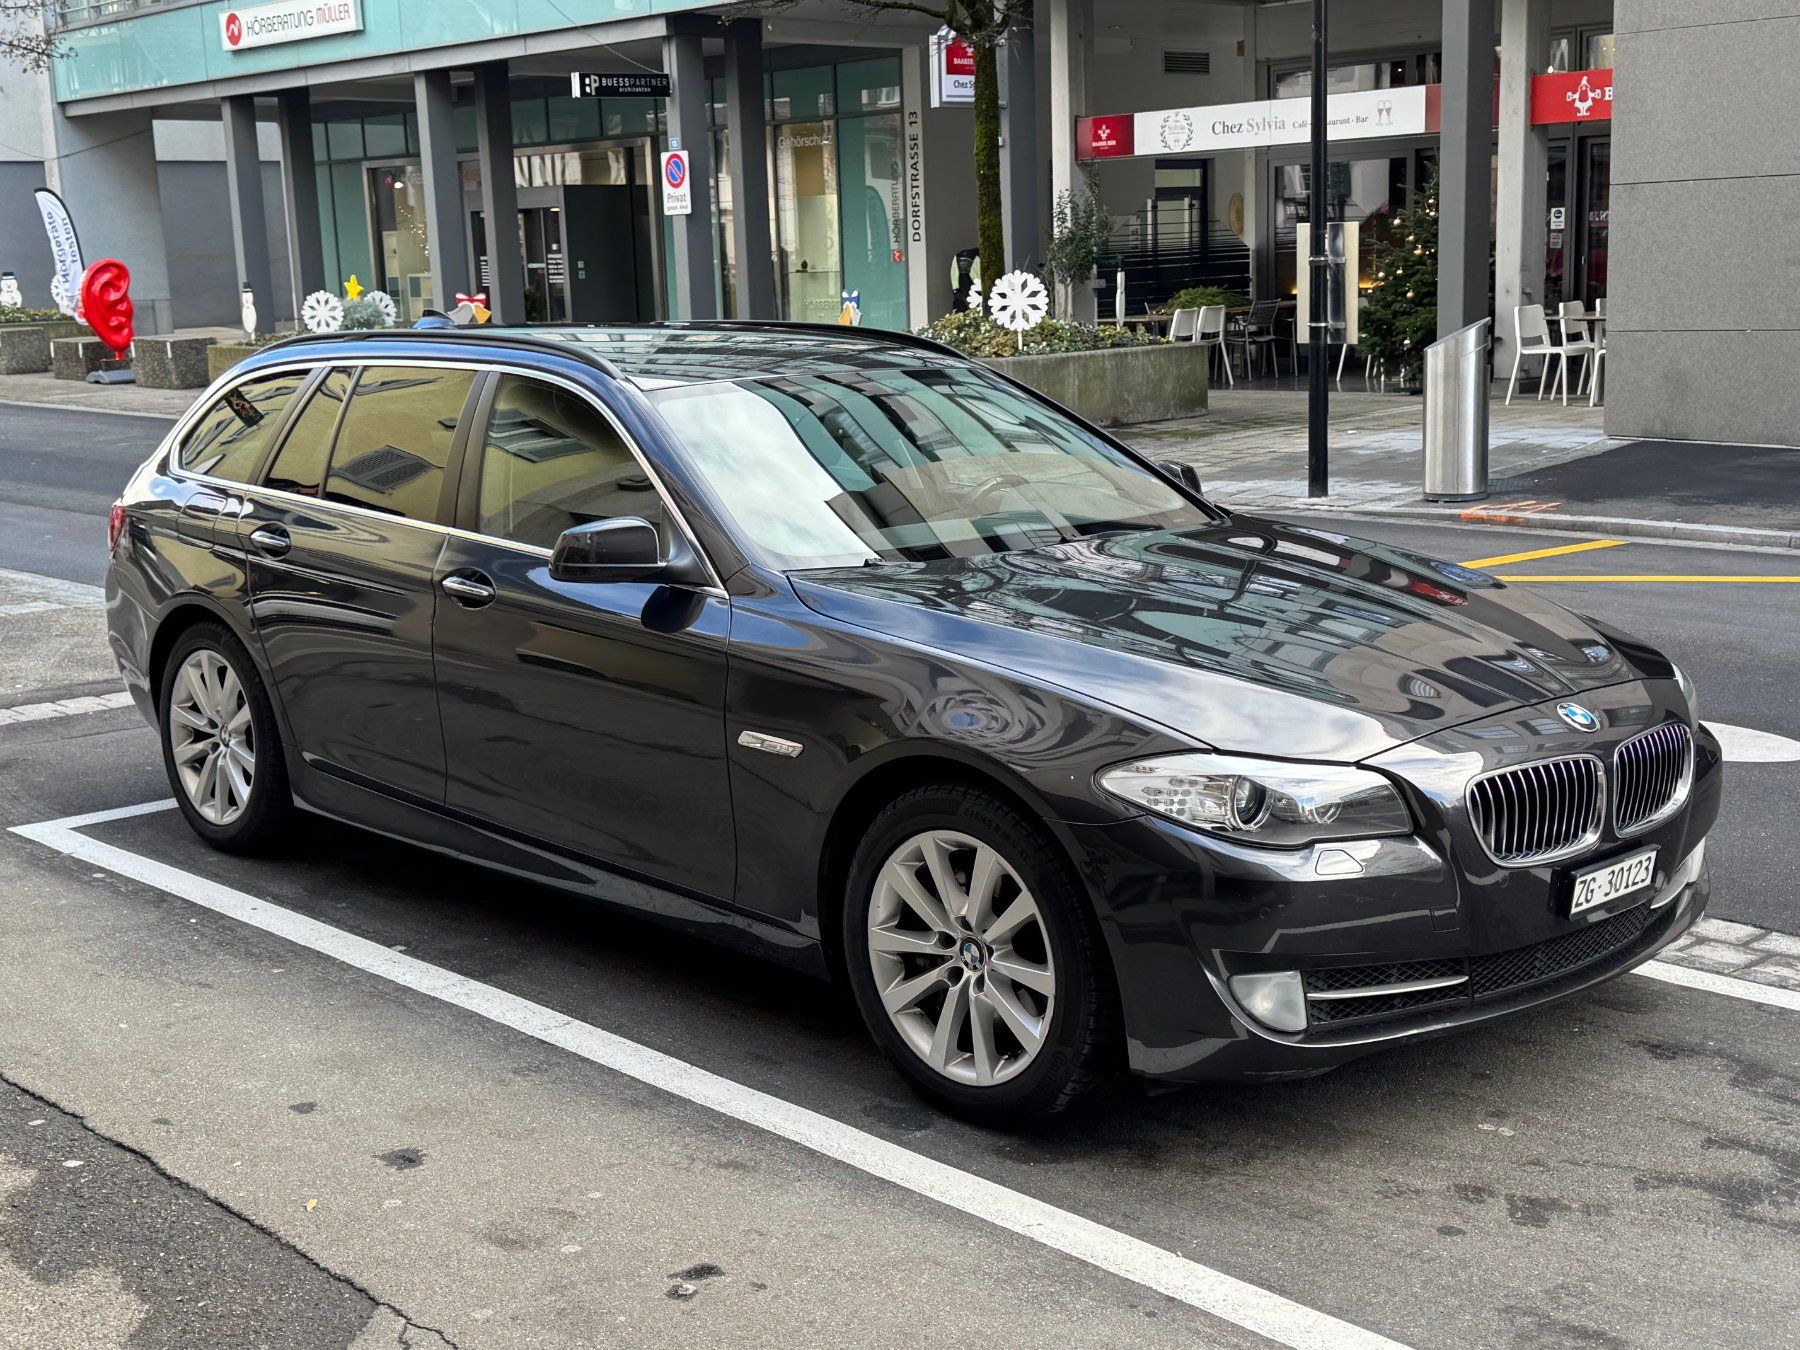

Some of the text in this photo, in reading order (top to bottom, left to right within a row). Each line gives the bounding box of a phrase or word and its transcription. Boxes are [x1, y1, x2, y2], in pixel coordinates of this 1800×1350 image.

[246, 3, 351, 37] HÖRBERATUNG MÜLLER
[602, 77, 668, 87] BUESSPARTNER
[953, 79, 968, 89] Chez
[1211, 116, 1286, 136] Chez Sylvia
[1292, 118, 1308, 129] Café
[1355, 115, 1369, 124] Bar
[777, 133, 833, 149] Gehörschutz
[908, 110, 922, 243] DORFSTRASSE 13
[666, 192, 687, 204] Privat
[61, 216, 79, 264] testen
[1574, 856, 1652, 908] ZG 30123
